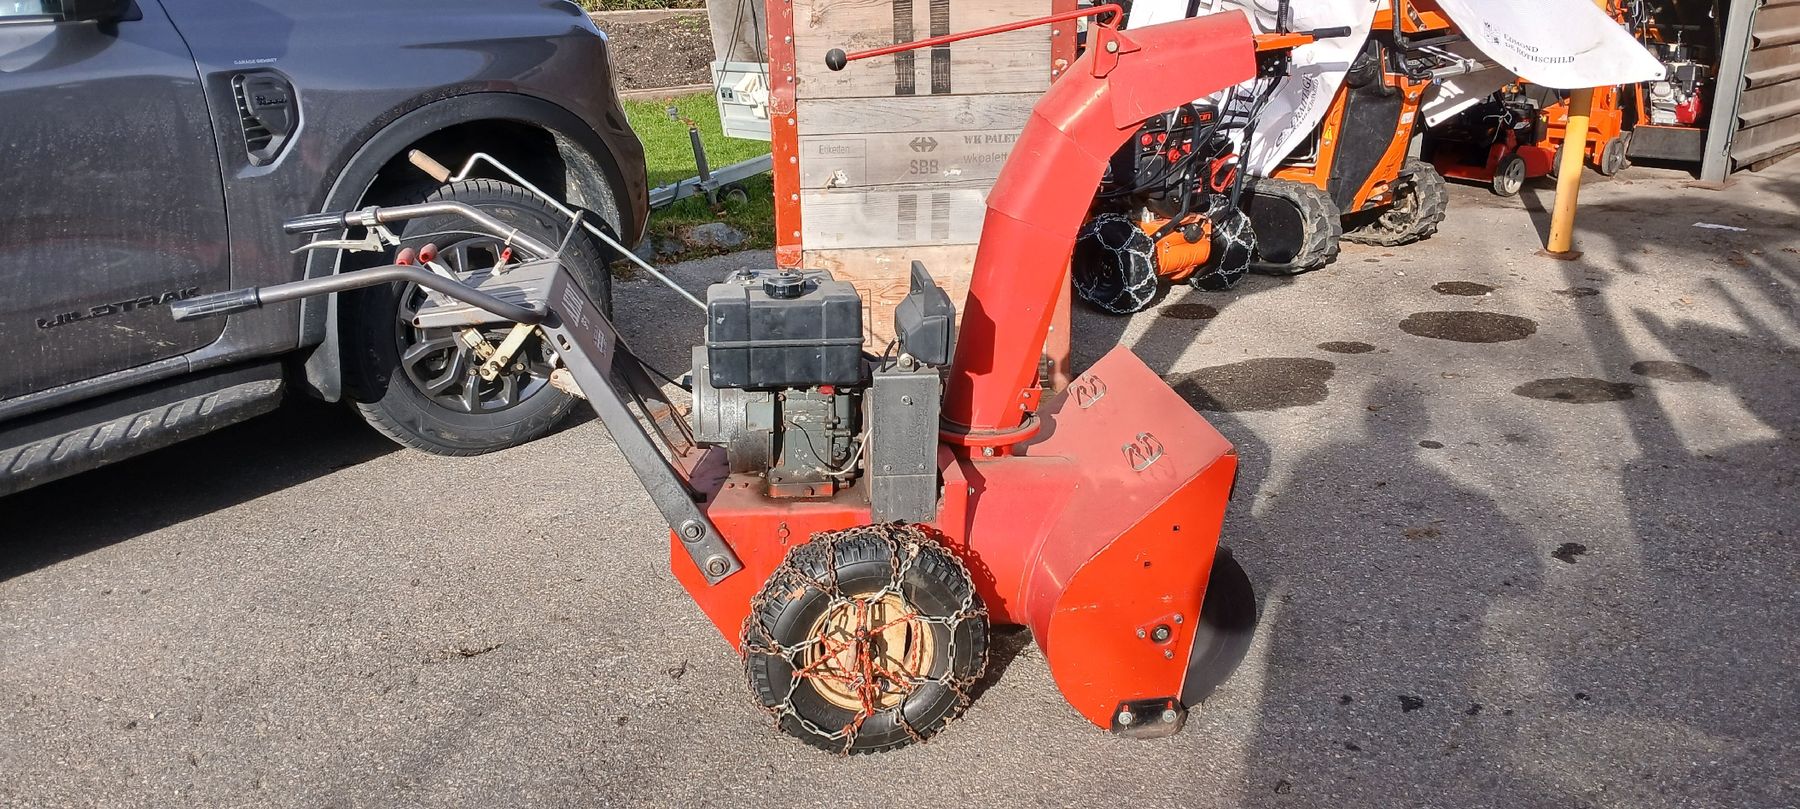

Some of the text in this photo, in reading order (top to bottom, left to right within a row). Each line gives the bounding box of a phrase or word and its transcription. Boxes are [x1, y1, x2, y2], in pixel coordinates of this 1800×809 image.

[1503, 33, 1539, 53] EDMOND
[1516, 46, 1575, 64] ROTHSCHILD
[963, 133, 1019, 145] WK PALET
[909, 159, 940, 175] SBB
